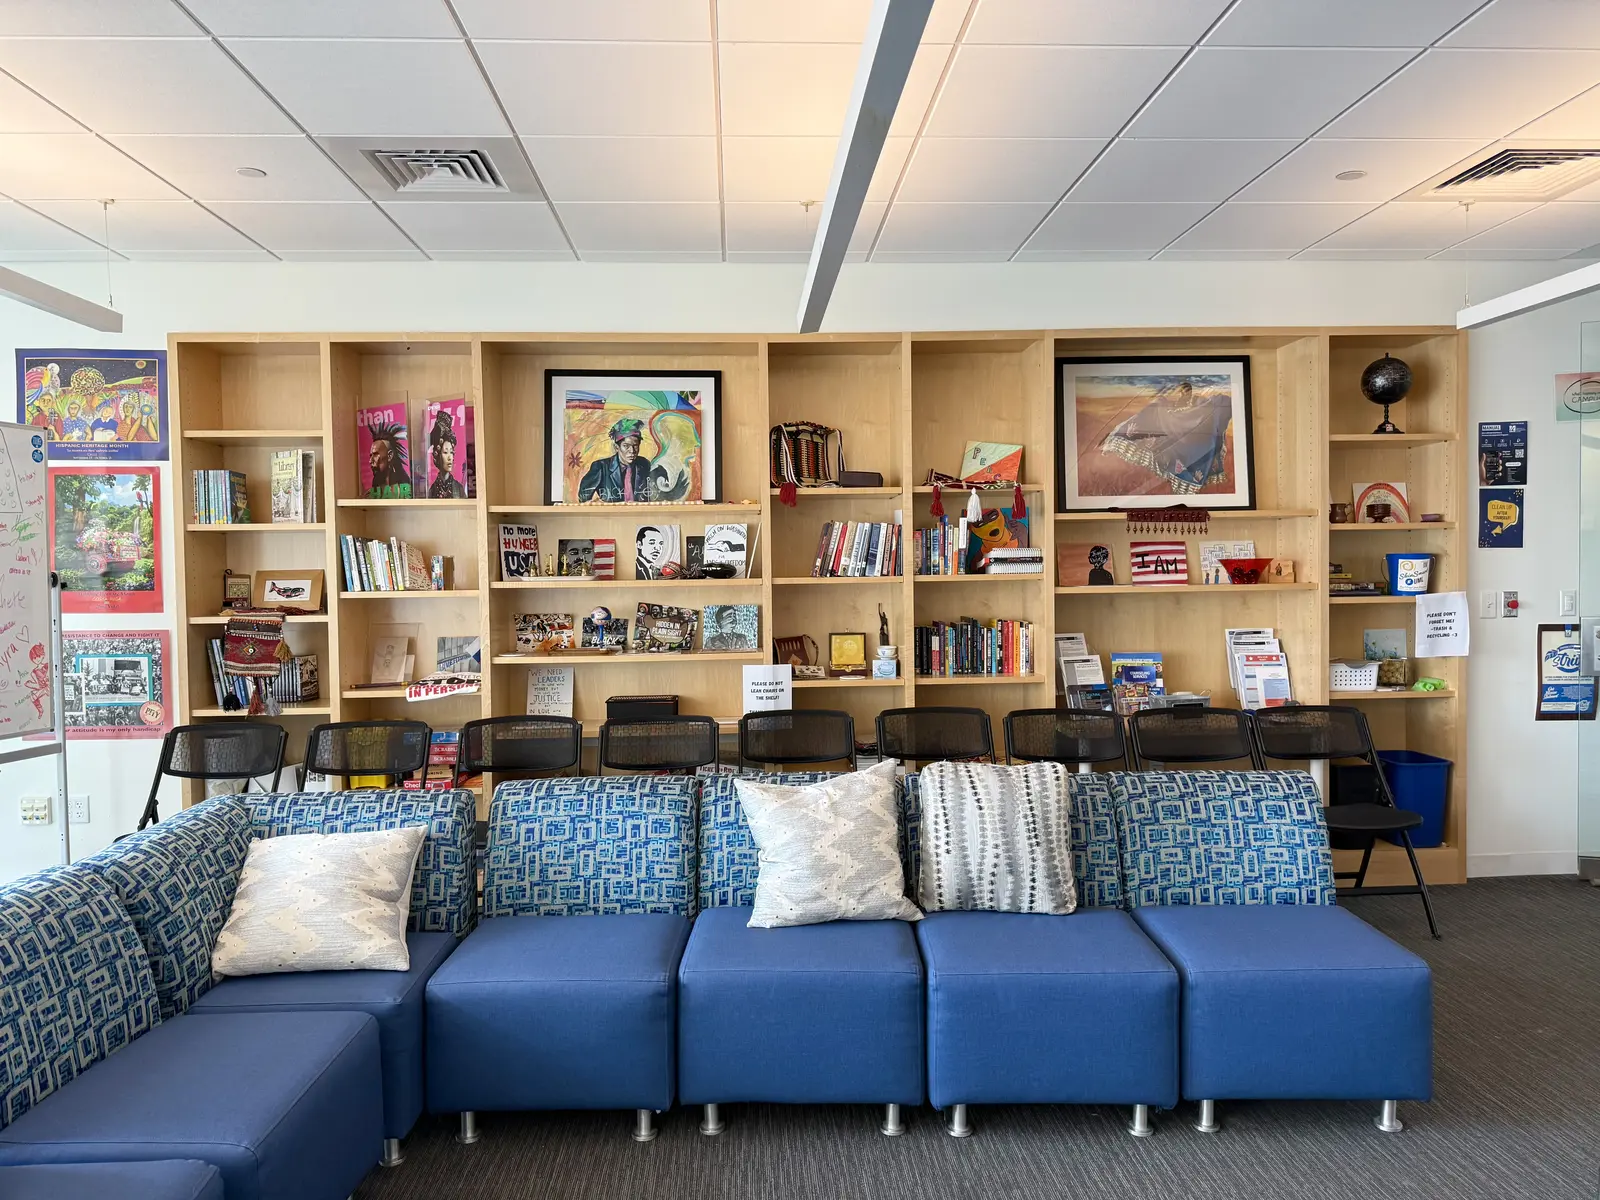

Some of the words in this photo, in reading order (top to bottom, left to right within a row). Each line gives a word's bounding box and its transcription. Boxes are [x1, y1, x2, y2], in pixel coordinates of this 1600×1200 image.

[356, 409, 394, 427] than
[503, 526, 514, 536] no
[517, 526, 536, 537] more
[408, 563, 423, 574] GRIT
[1135, 553, 1151, 569] I
[1153, 555, 1179, 575] AM
[655, 620, 674, 629] HIDDEN
[674, 621, 681, 630] IN
[651, 627, 667, 635] PLAIN
[667, 629, 683, 637] SIGHT
[403, 686, 421, 698] IN
[133, 726, 161, 734] handicap
